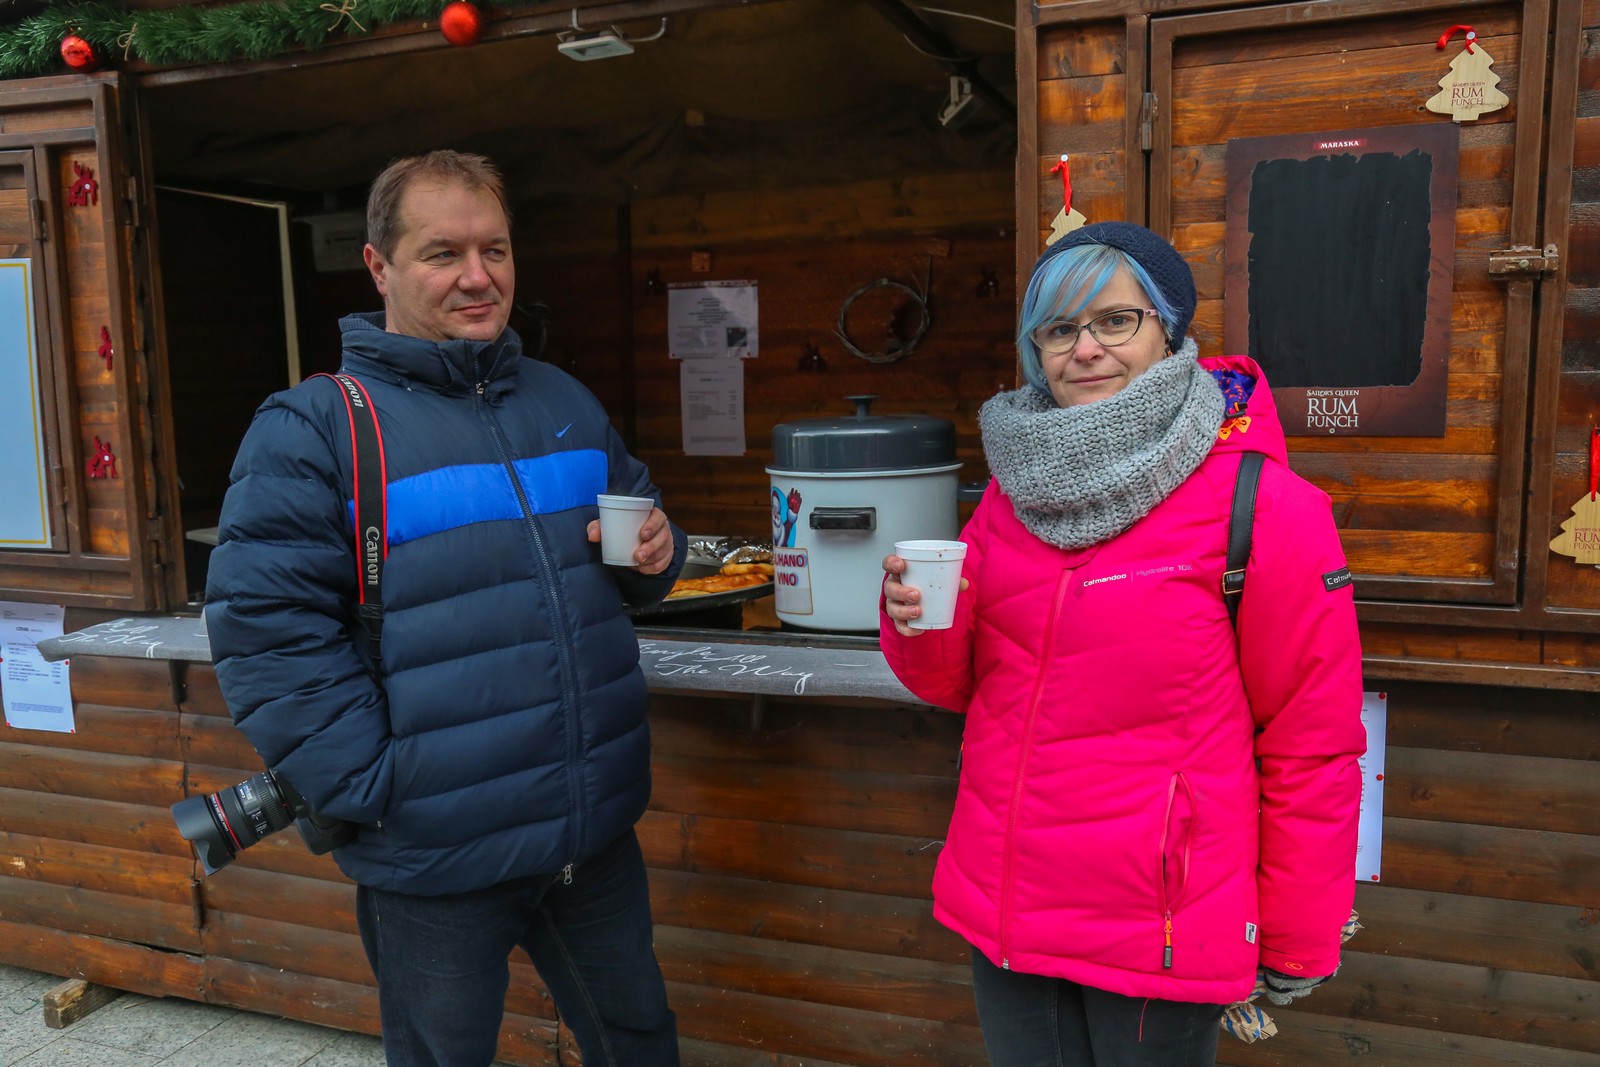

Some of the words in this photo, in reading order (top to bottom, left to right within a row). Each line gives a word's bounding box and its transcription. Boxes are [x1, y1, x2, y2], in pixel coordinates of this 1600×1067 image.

[1452, 87, 1484, 99] RUM
[1451, 98, 1484, 107] PUNCH
[1320, 140, 1360, 149] MARASKA
[1335, 389, 1360, 397] QUEEN
[1307, 397, 1359, 416] RUM
[1307, 415, 1359, 428] PUNCH
[1573, 542, 1600, 550] PUNC
[366, 526, 380, 586] Canon
[777, 573, 798, 587] VINO
[1083, 573, 1127, 587] Catmandoo
[654, 663, 711, 677] The
[718, 663, 814, 695] Way
